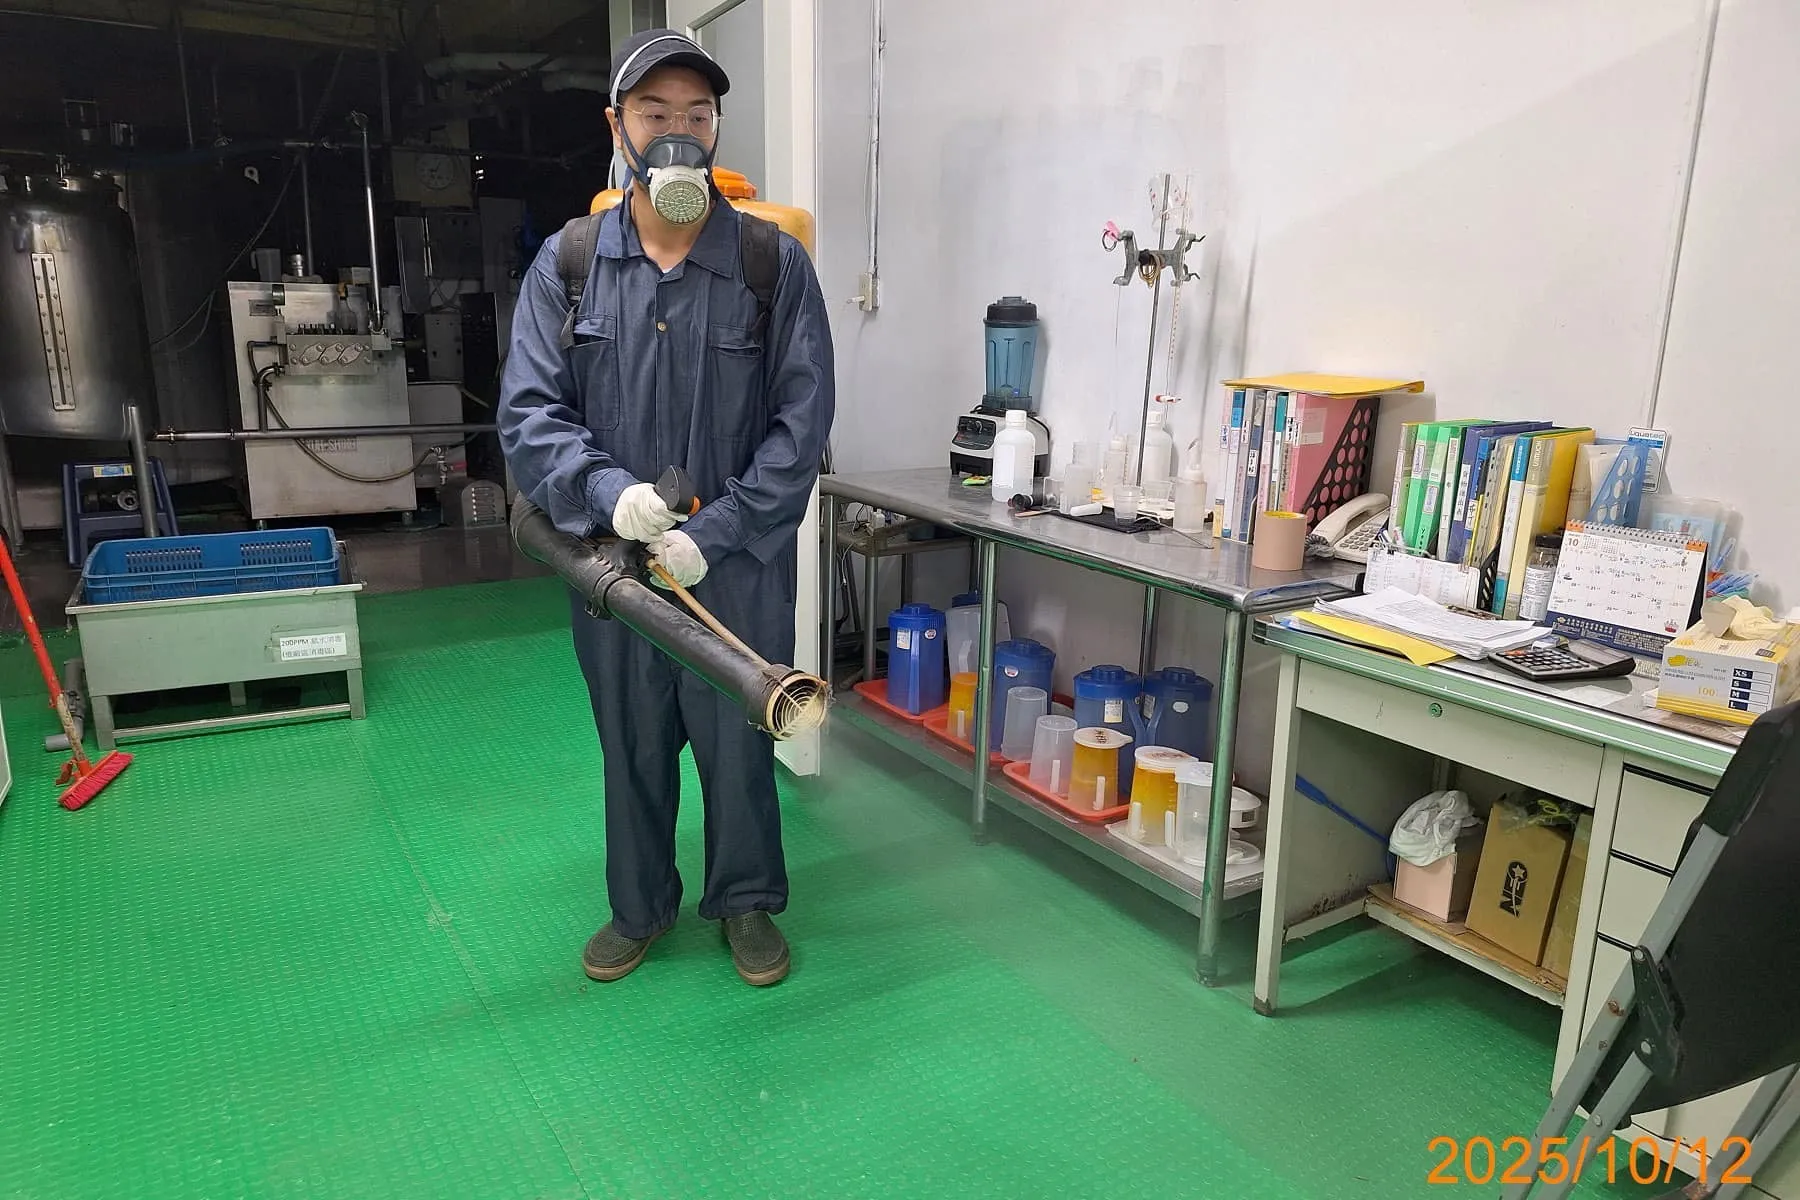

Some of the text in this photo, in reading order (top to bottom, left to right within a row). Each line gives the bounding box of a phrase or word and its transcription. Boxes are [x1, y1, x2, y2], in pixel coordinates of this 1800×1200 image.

[1734, 669, 1748, 678] XS
[1731, 690, 1740, 698] M
[1729, 701, 1736, 709] L
